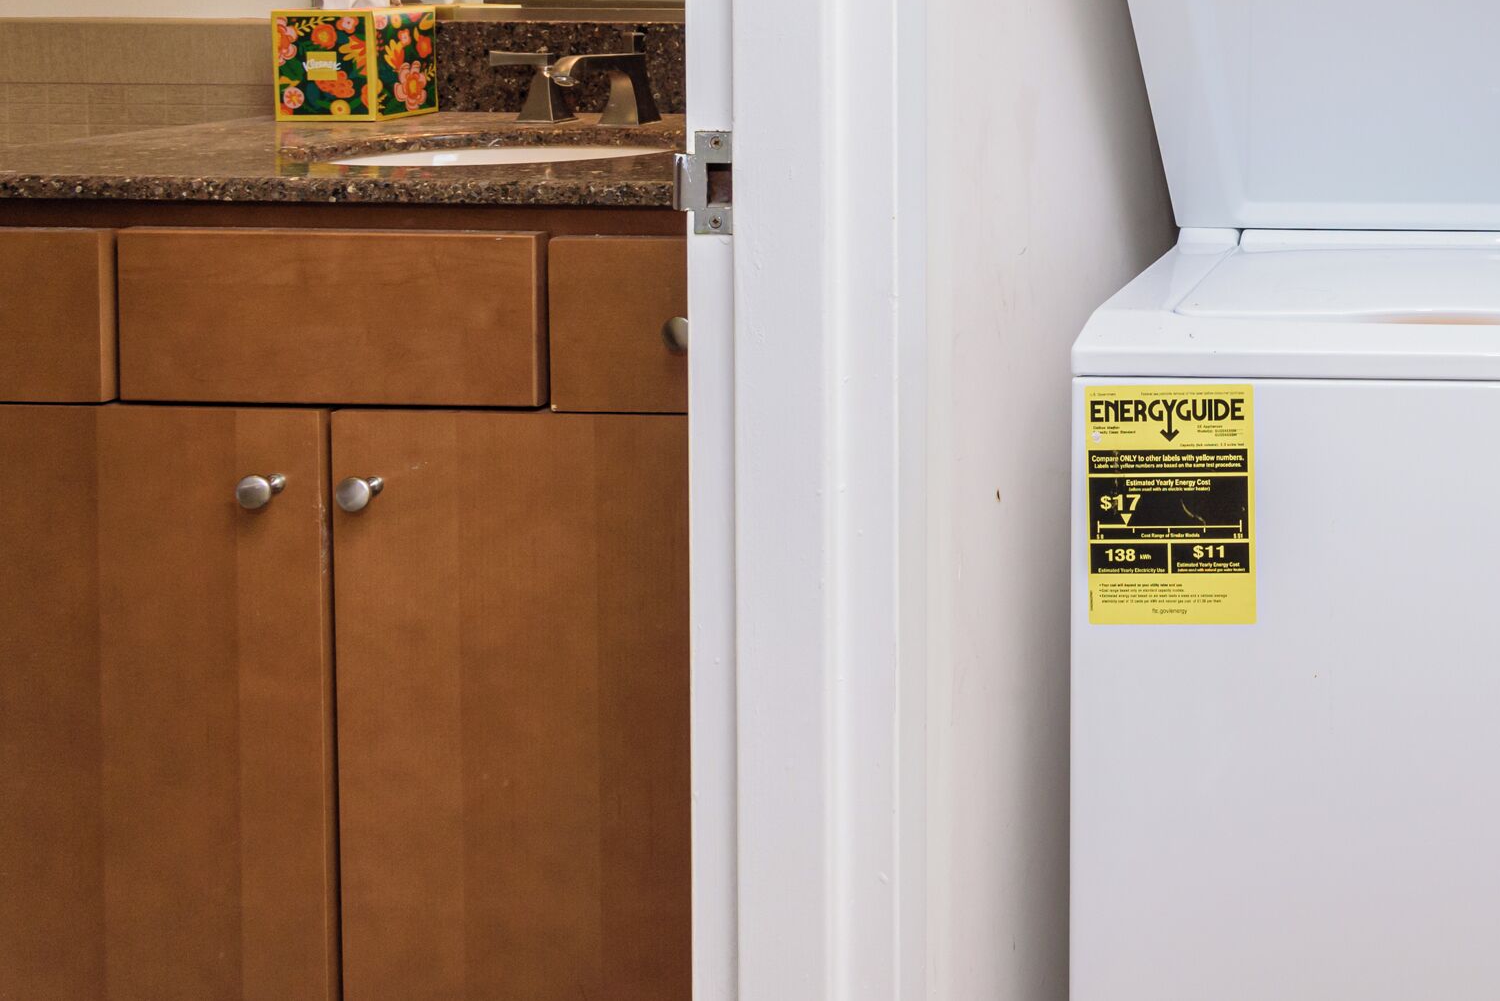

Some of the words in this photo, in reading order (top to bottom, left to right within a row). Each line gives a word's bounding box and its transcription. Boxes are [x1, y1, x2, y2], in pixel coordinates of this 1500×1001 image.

[1090, 399, 1245, 423] ENERGYGUIDE
[1091, 455, 1119, 463] Compare
[1120, 454, 1137, 462] ONLY
[1162, 454, 1181, 462] labels
[1195, 454, 1215, 463] yellow
[1156, 479, 1174, 487] Yearly
[1174, 479, 1196, 487] Energy
[1100, 493, 1141, 511] $17
[1105, 548, 1136, 562] 138
[1193, 545, 1225, 559] $11
